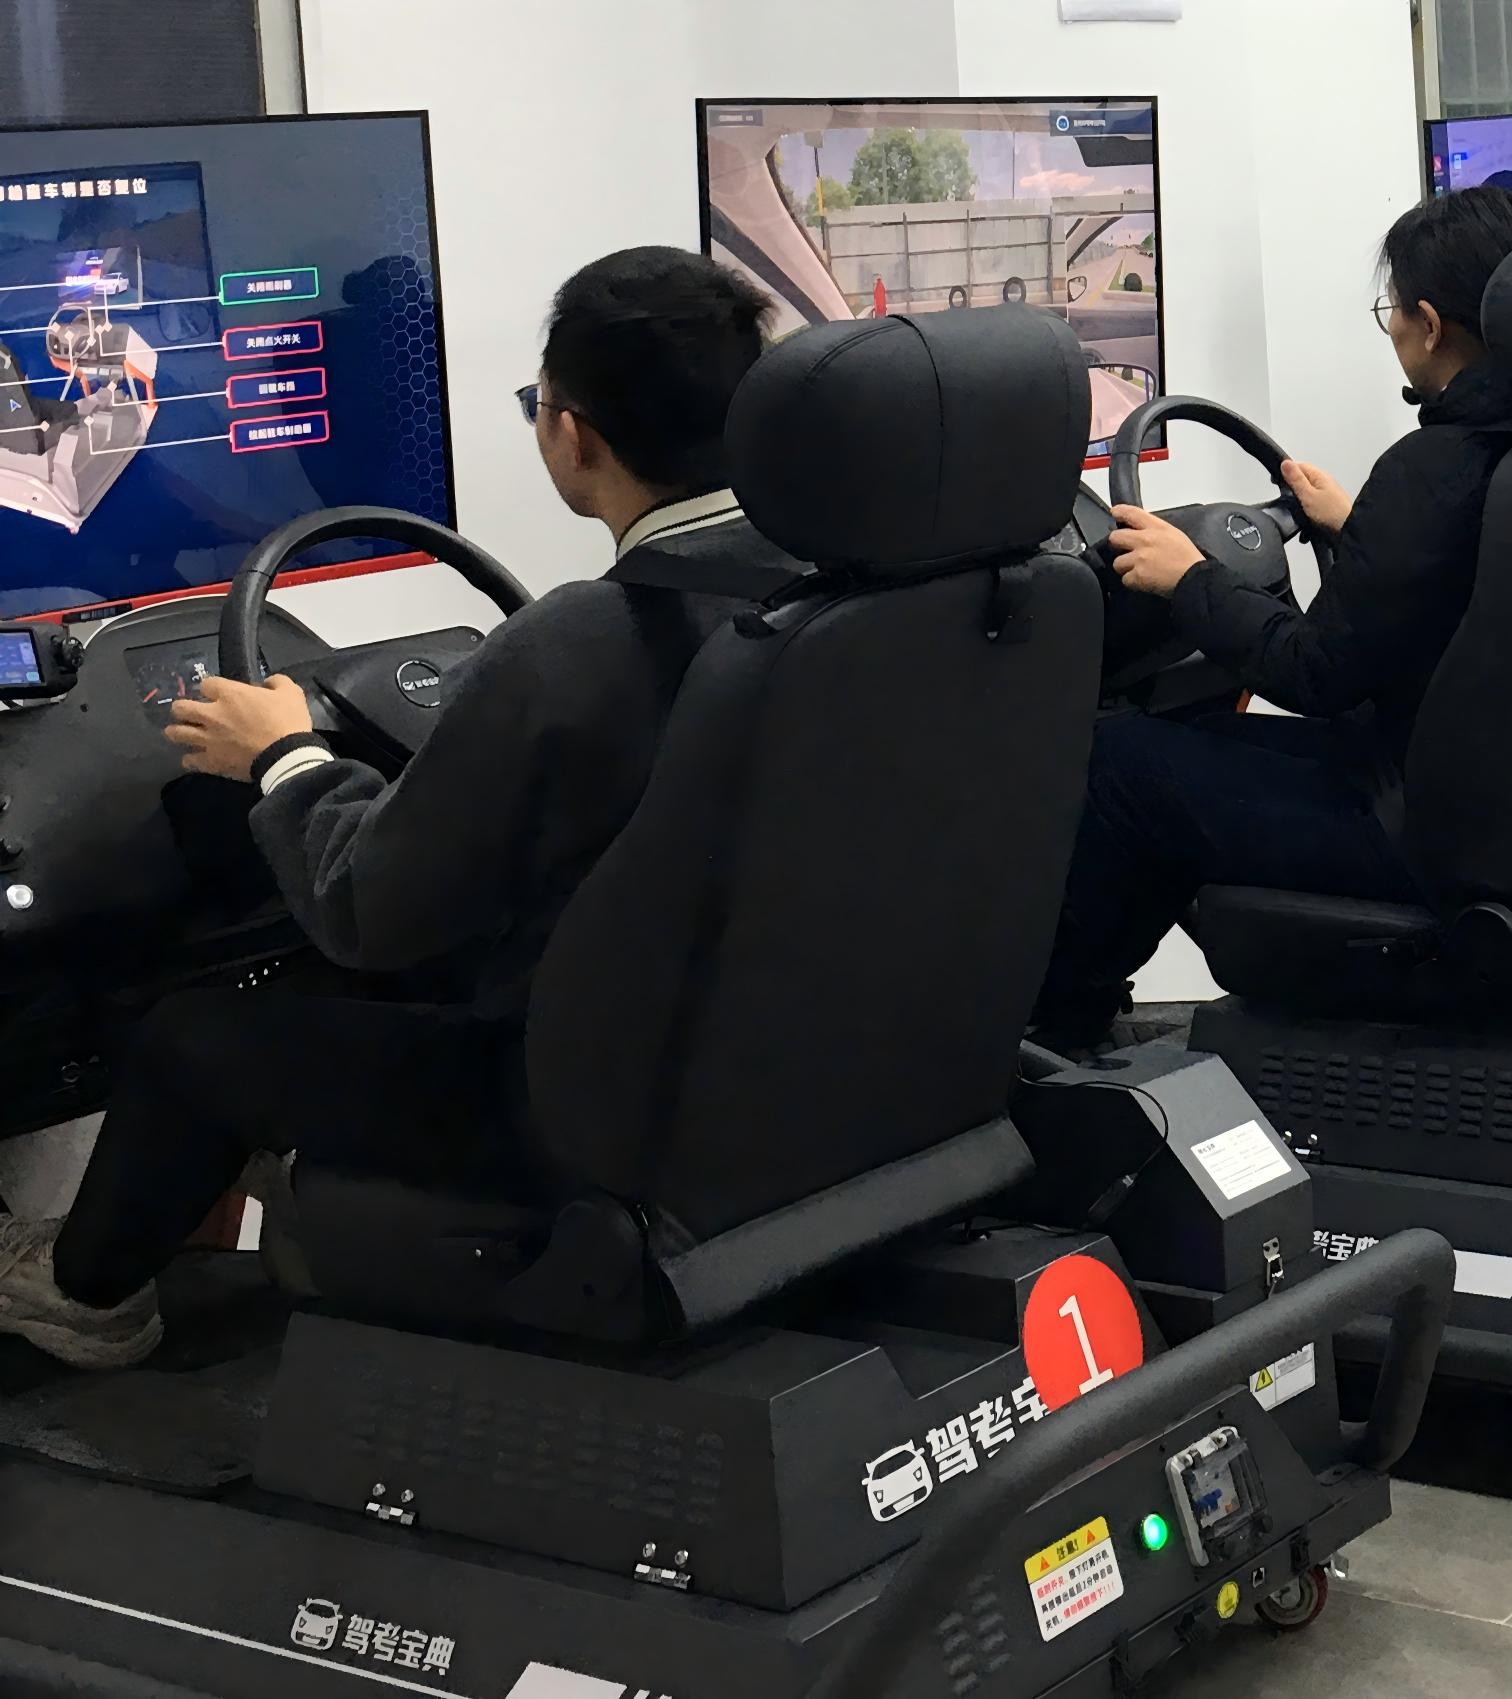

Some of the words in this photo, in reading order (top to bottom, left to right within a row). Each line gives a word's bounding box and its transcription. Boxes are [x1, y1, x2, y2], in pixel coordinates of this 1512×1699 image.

[1059, 1295, 1114, 1395] 1
[341, 1614, 455, 1676] 驾考宝典
